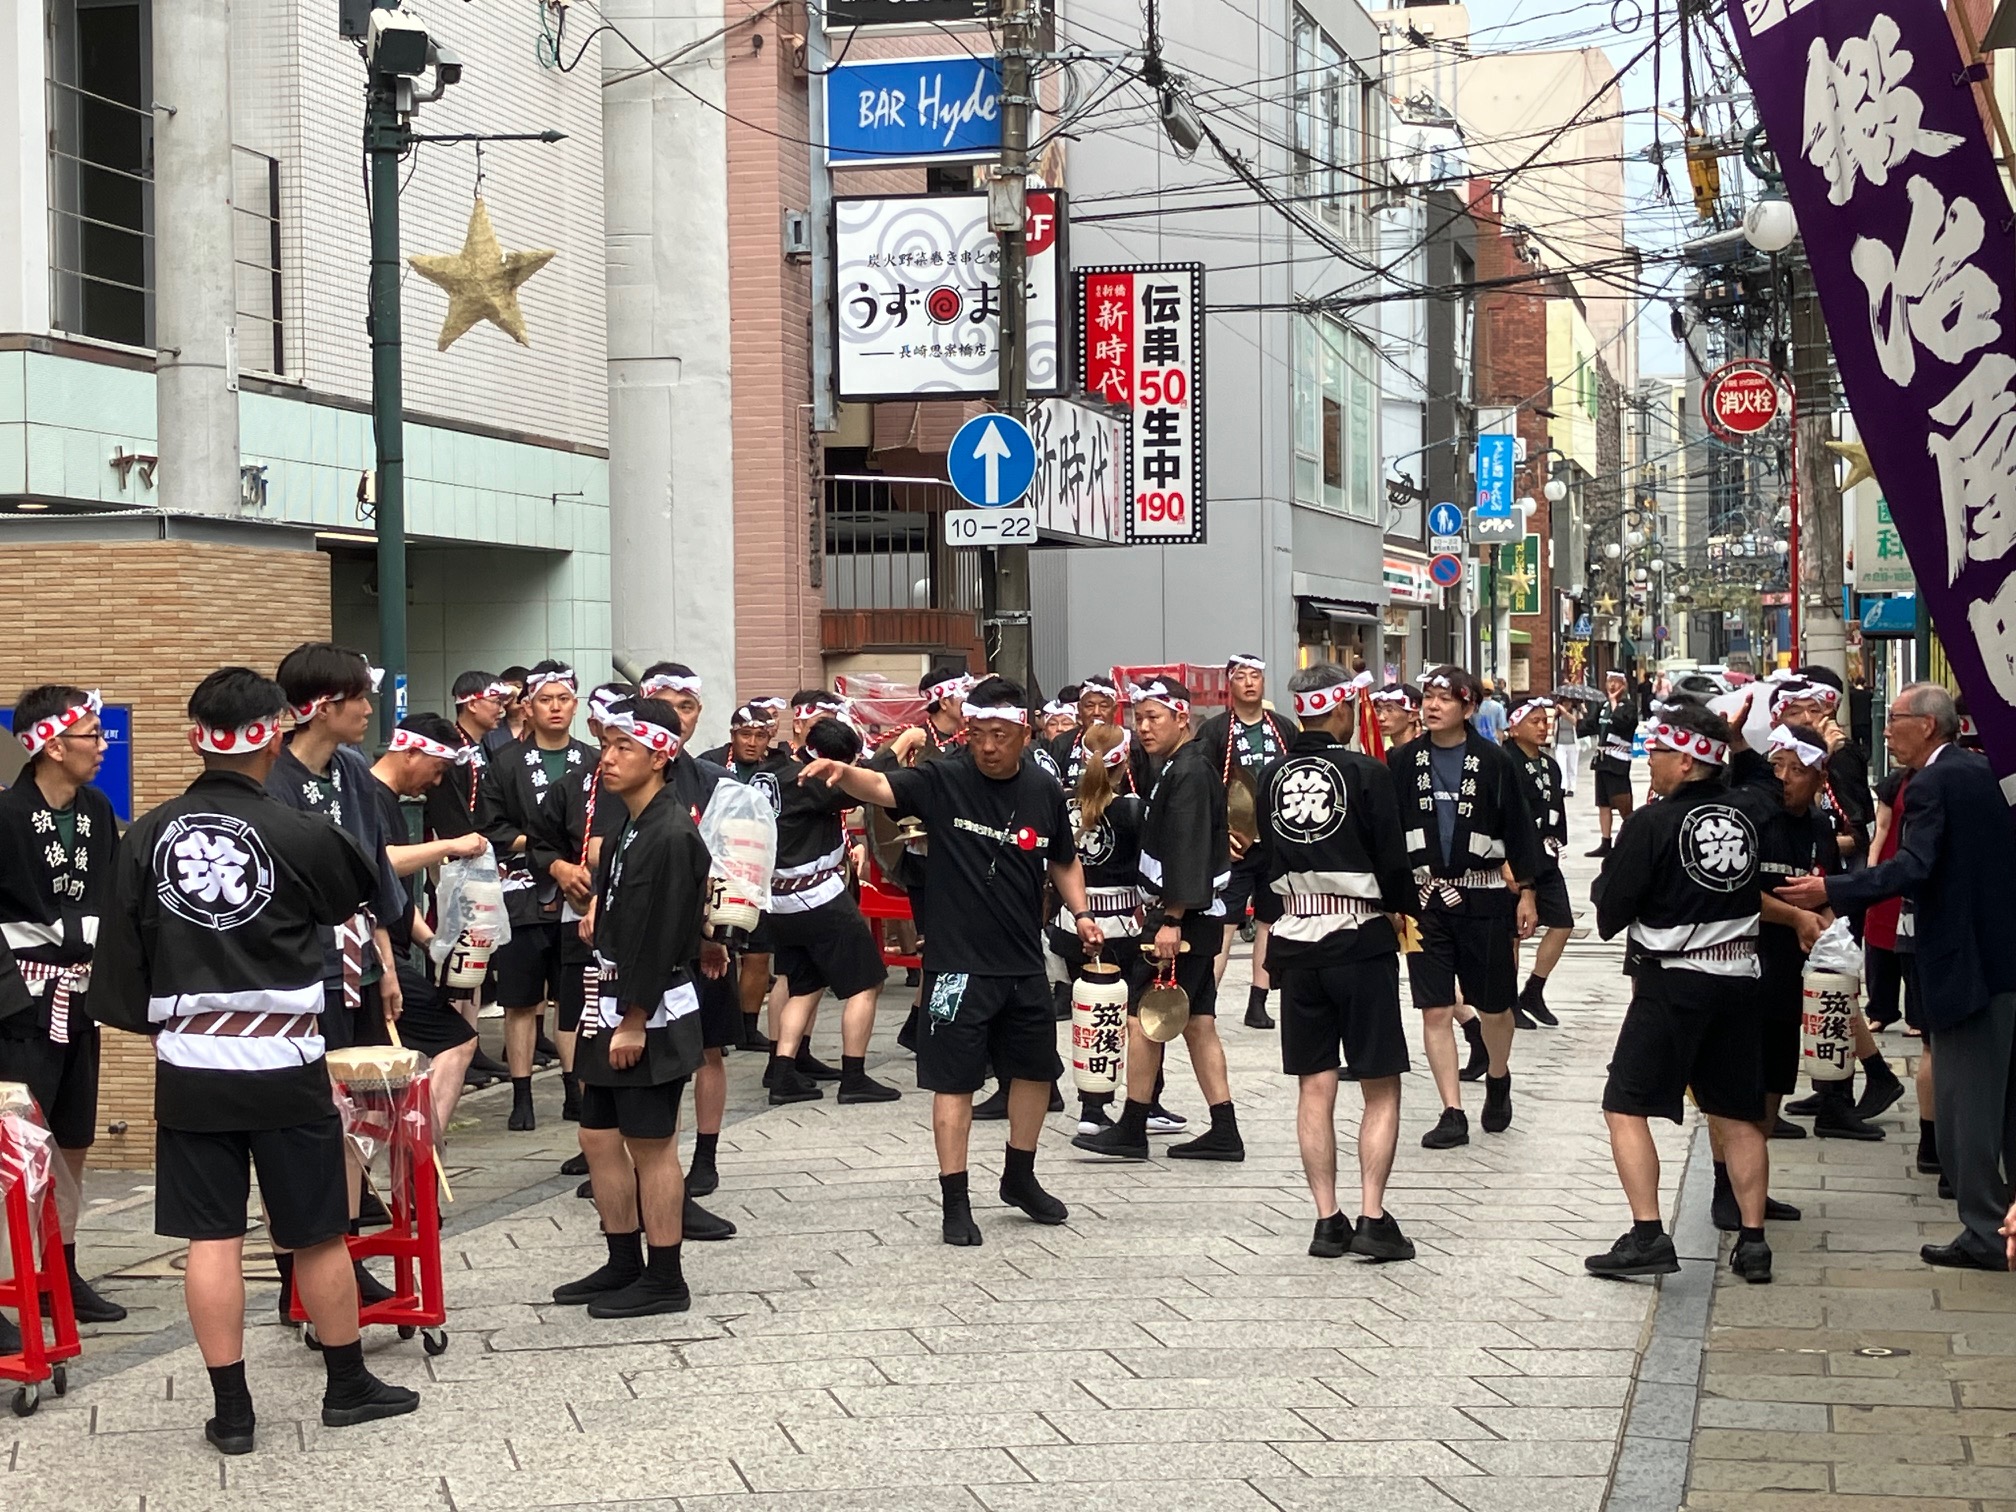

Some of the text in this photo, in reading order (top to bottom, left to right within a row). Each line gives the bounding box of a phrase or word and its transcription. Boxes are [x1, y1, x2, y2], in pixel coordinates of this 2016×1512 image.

[858, 67, 997, 147] BAR Hyde
[850, 281, 1037, 329] うずま
[1095, 300, 1128, 400] 新時代
[1720, 388, 1773, 415] 消火栓
[1281, 770, 1331, 824] 筑
[1415, 750, 1434, 812] 筑後町
[1457, 754, 1480, 818] 筑後町
[31, 810, 70, 894] 筑後町
[67, 813, 92, 902] 筑後町
[174, 830, 250, 905] 筑
[1694, 818, 1748, 873] 筑
[1088, 1002, 1123, 1082] 筑後町
[1820, 990, 1851, 1070] 筑後町
